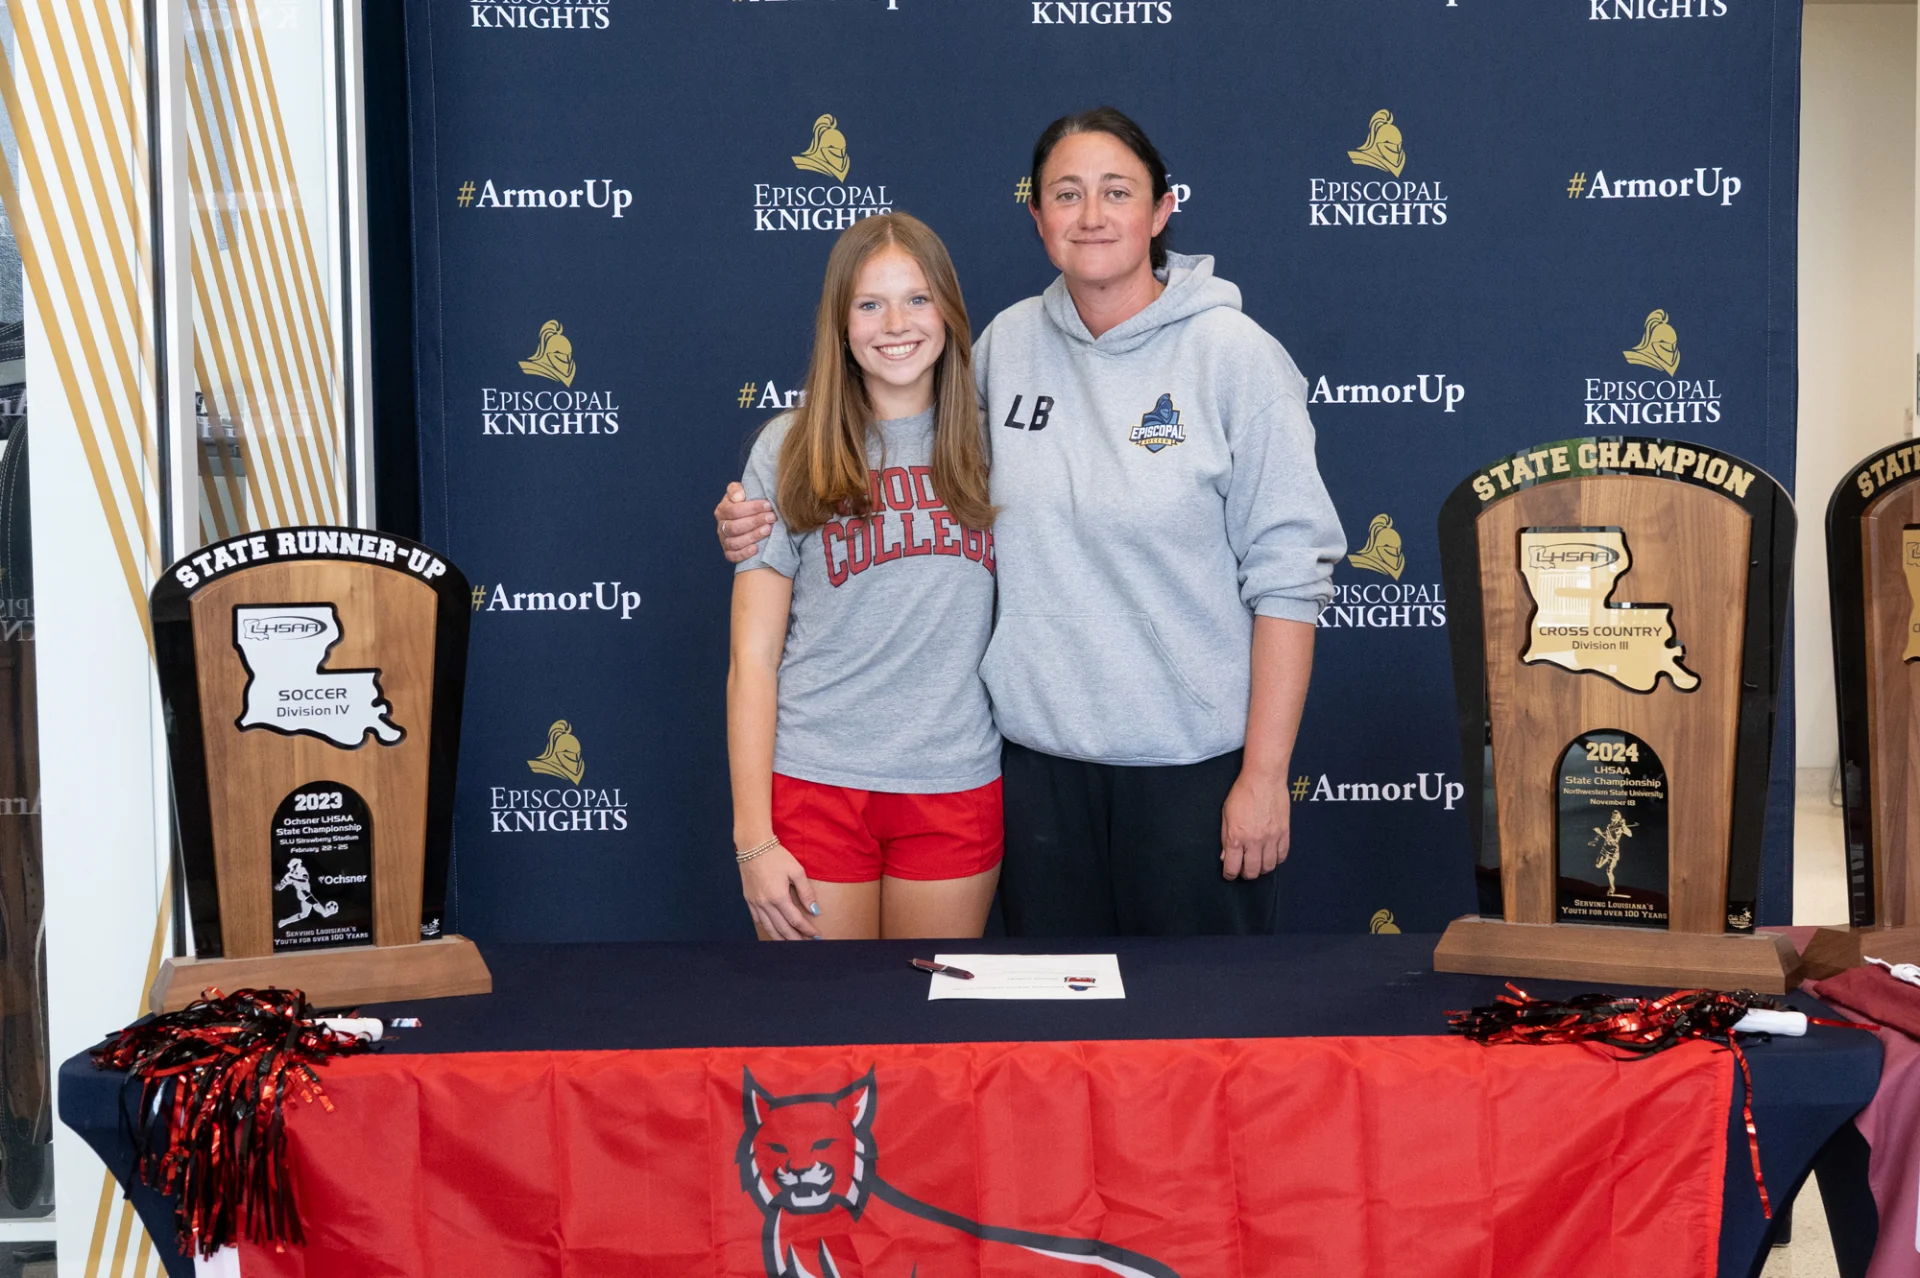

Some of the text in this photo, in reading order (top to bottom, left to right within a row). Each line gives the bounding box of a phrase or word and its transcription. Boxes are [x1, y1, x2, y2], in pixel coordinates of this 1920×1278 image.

[470, 5, 610, 29] KNIGHTS
[1031, 1, 1172, 24] KNIGHTS
[1589, 0, 1727, 20] KNIGHTS
[753, 184, 893, 207] EPISCOPAL
[1310, 178, 1448, 202] EPISCOPAL
[1567, 167, 1742, 206] #ArmorUp
[457, 178, 633, 218] #ArmorUp
[1310, 202, 1448, 226] KNIGHTS
[481, 388, 619, 411] EPISCOPAL
[1308, 374, 1465, 412] ArmorUp
[1584, 378, 1722, 401] EPISCOPAL
[1004, 394, 1054, 431] LB
[1584, 401, 1721, 425] KNIGHTS
[482, 412, 619, 435] KNIGHTS
[1130, 425, 1185, 440] EPISCOPAL
[1472, 442, 1755, 501] STATE CHAMPION
[175, 531, 447, 589] STATE RUNNER-UP
[1536, 551, 1610, 562] LHSAA
[471, 582, 641, 619] #ArmorUp
[1328, 583, 1446, 604] PISCOPAL
[250, 621, 319, 634] LHSAA
[1539, 626, 1663, 637] CROSS COUNTRY
[1572, 641, 1629, 650] Division III
[278, 688, 347, 701] SOCCER
[277, 704, 350, 718] Division IV
[1586, 742, 1639, 762] 2024
[1594, 766, 1631, 775] LHSAA
[1291, 773, 1464, 810] #ArmorUp
[1565, 776, 1661, 788] State Championship
[294, 792, 343, 811] 2023
[490, 787, 628, 810] EPISCOPAL
[1563, 788, 1663, 799] Northwestern State University
[1590, 798, 1626, 806] November
[276, 823, 362, 836] State Championship
[283, 814, 354, 826] Ochsner LHSAA
[491, 809, 628, 832] KNIGHTS
[296, 836, 331, 844] Strawberry
[332, 834, 359, 842] Stadium
[324, 874, 367, 885] Ochsner
[1561, 906, 1587, 915] YOUTH
[1624, 910, 1640, 918] 100
[1641, 911, 1668, 919] YEARS
[1574, 899, 1606, 908] SERVING
[273, 938, 298, 946] YOUTH
[331, 933, 344, 941] 100
[346, 932, 369, 940] YEARS
[285, 929, 315, 938] SERVING
